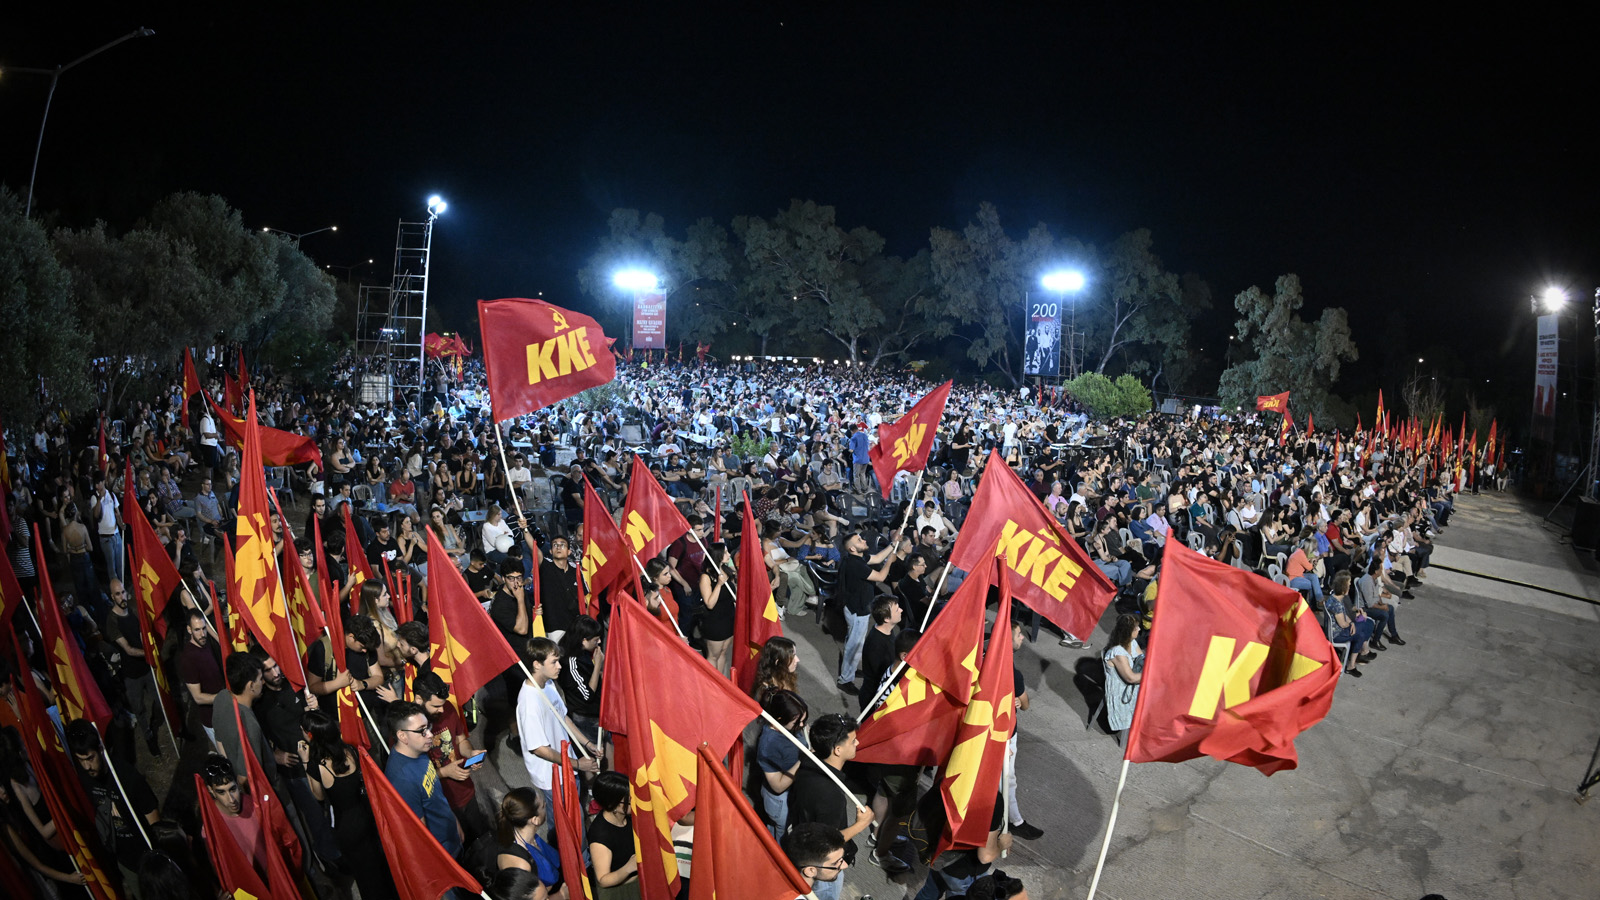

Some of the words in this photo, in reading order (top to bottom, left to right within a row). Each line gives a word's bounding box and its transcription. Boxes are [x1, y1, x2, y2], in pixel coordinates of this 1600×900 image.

[1031, 303, 1057, 318] 200
[526, 326, 597, 385] ΚΚΕ
[995, 518, 1084, 602] ΚΚΕ
